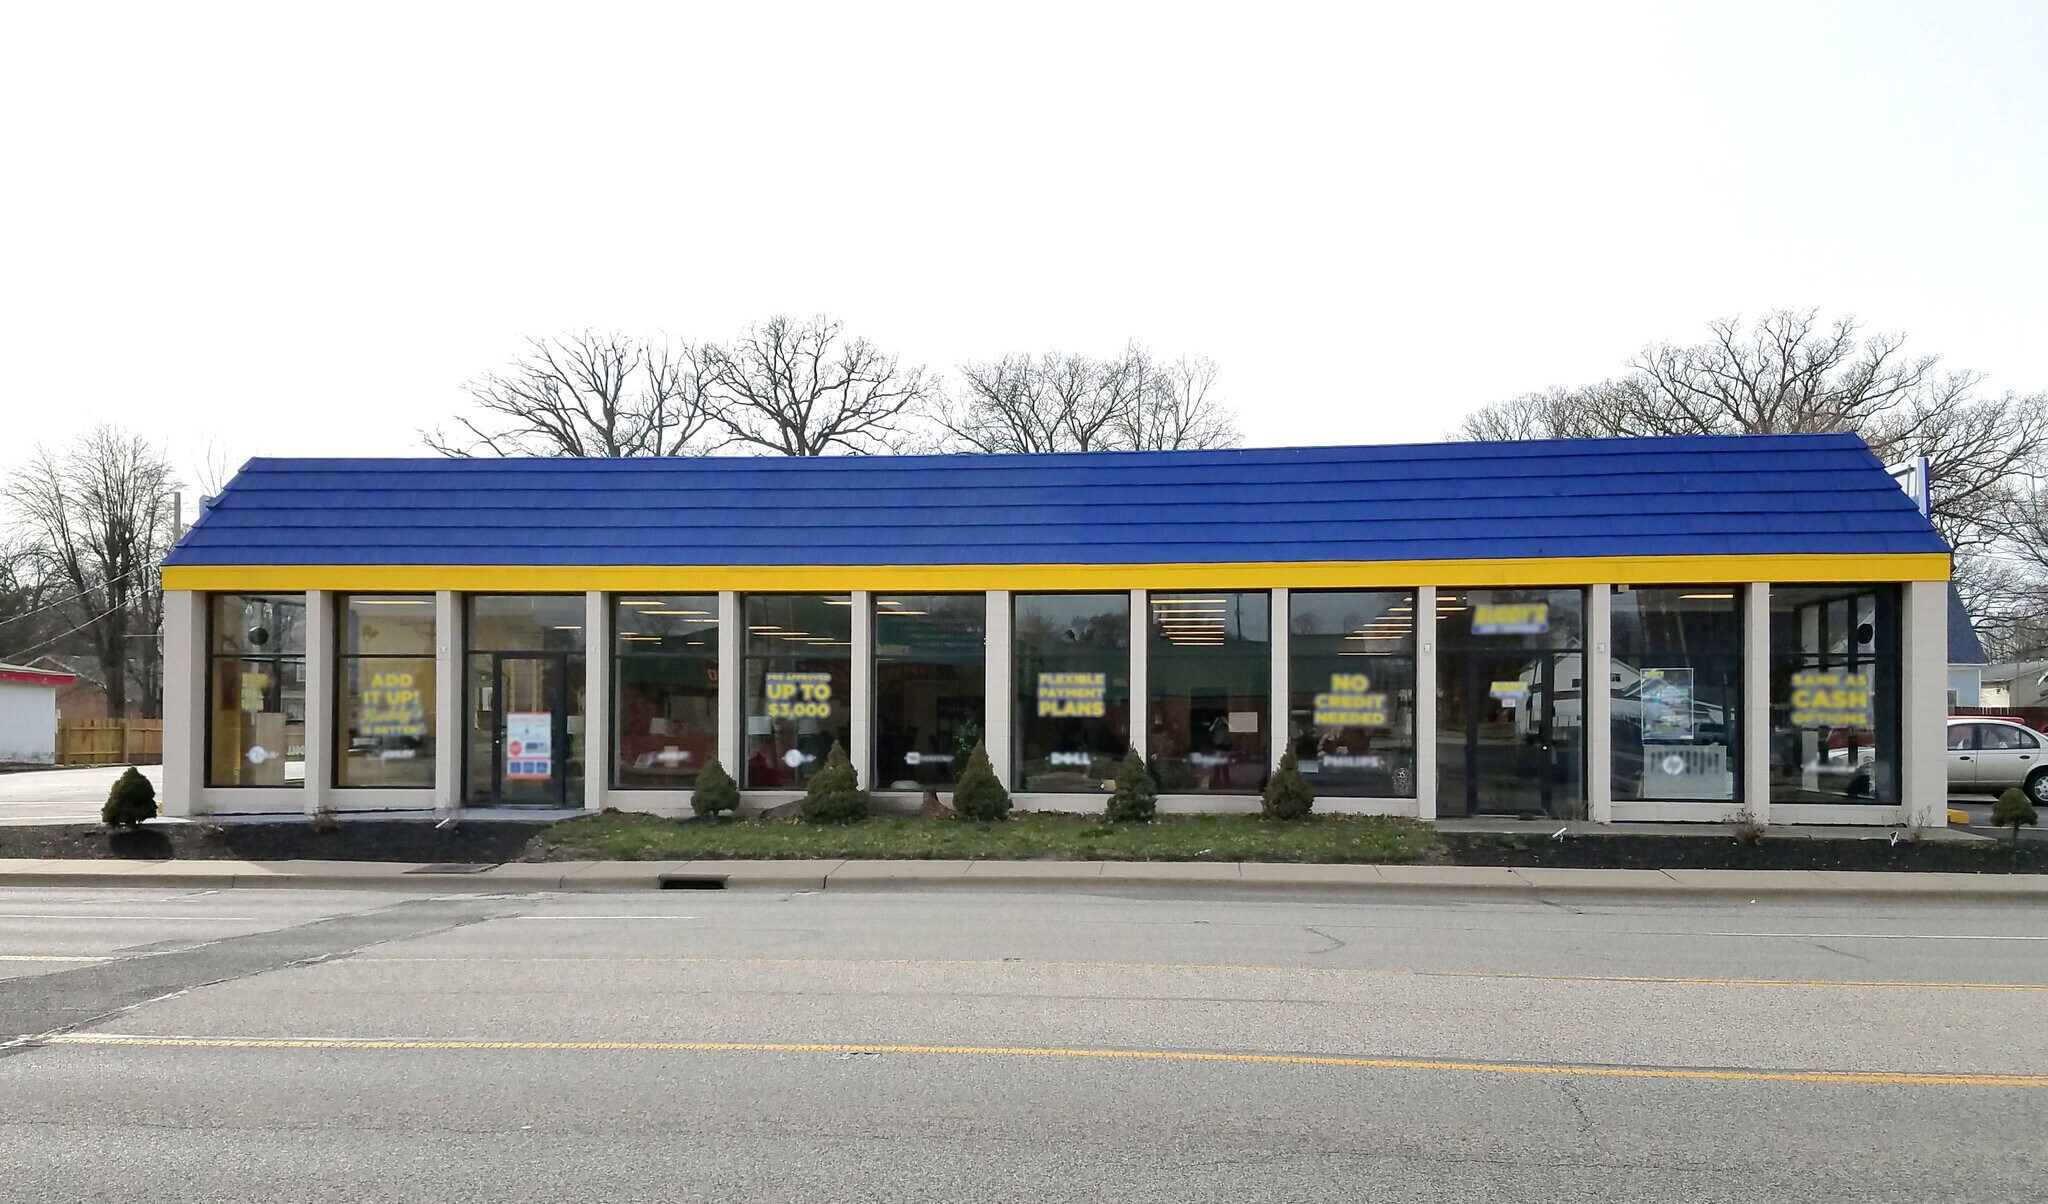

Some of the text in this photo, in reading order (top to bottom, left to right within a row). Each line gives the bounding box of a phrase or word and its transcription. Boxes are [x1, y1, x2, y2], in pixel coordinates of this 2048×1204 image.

[370, 673, 413, 688] ADD
[1039, 674, 1104, 685] FLEXIBLE
[1331, 674, 1369, 693] NO
[1792, 674, 1867, 687] SAME AS
[363, 690, 419, 704] IT UP!
[767, 683, 831, 700] UP TO
[1038, 687, 1104, 698] PAYMENT
[1791, 689, 1868, 709] CASH
[1038, 700, 1105, 717] PLANS
[1314, 694, 1386, 709] CREDIT
[768, 703, 830, 717] $3,000
[1313, 711, 1386, 725] NEEDED
[1791, 711, 1868, 726] OPTIONS
